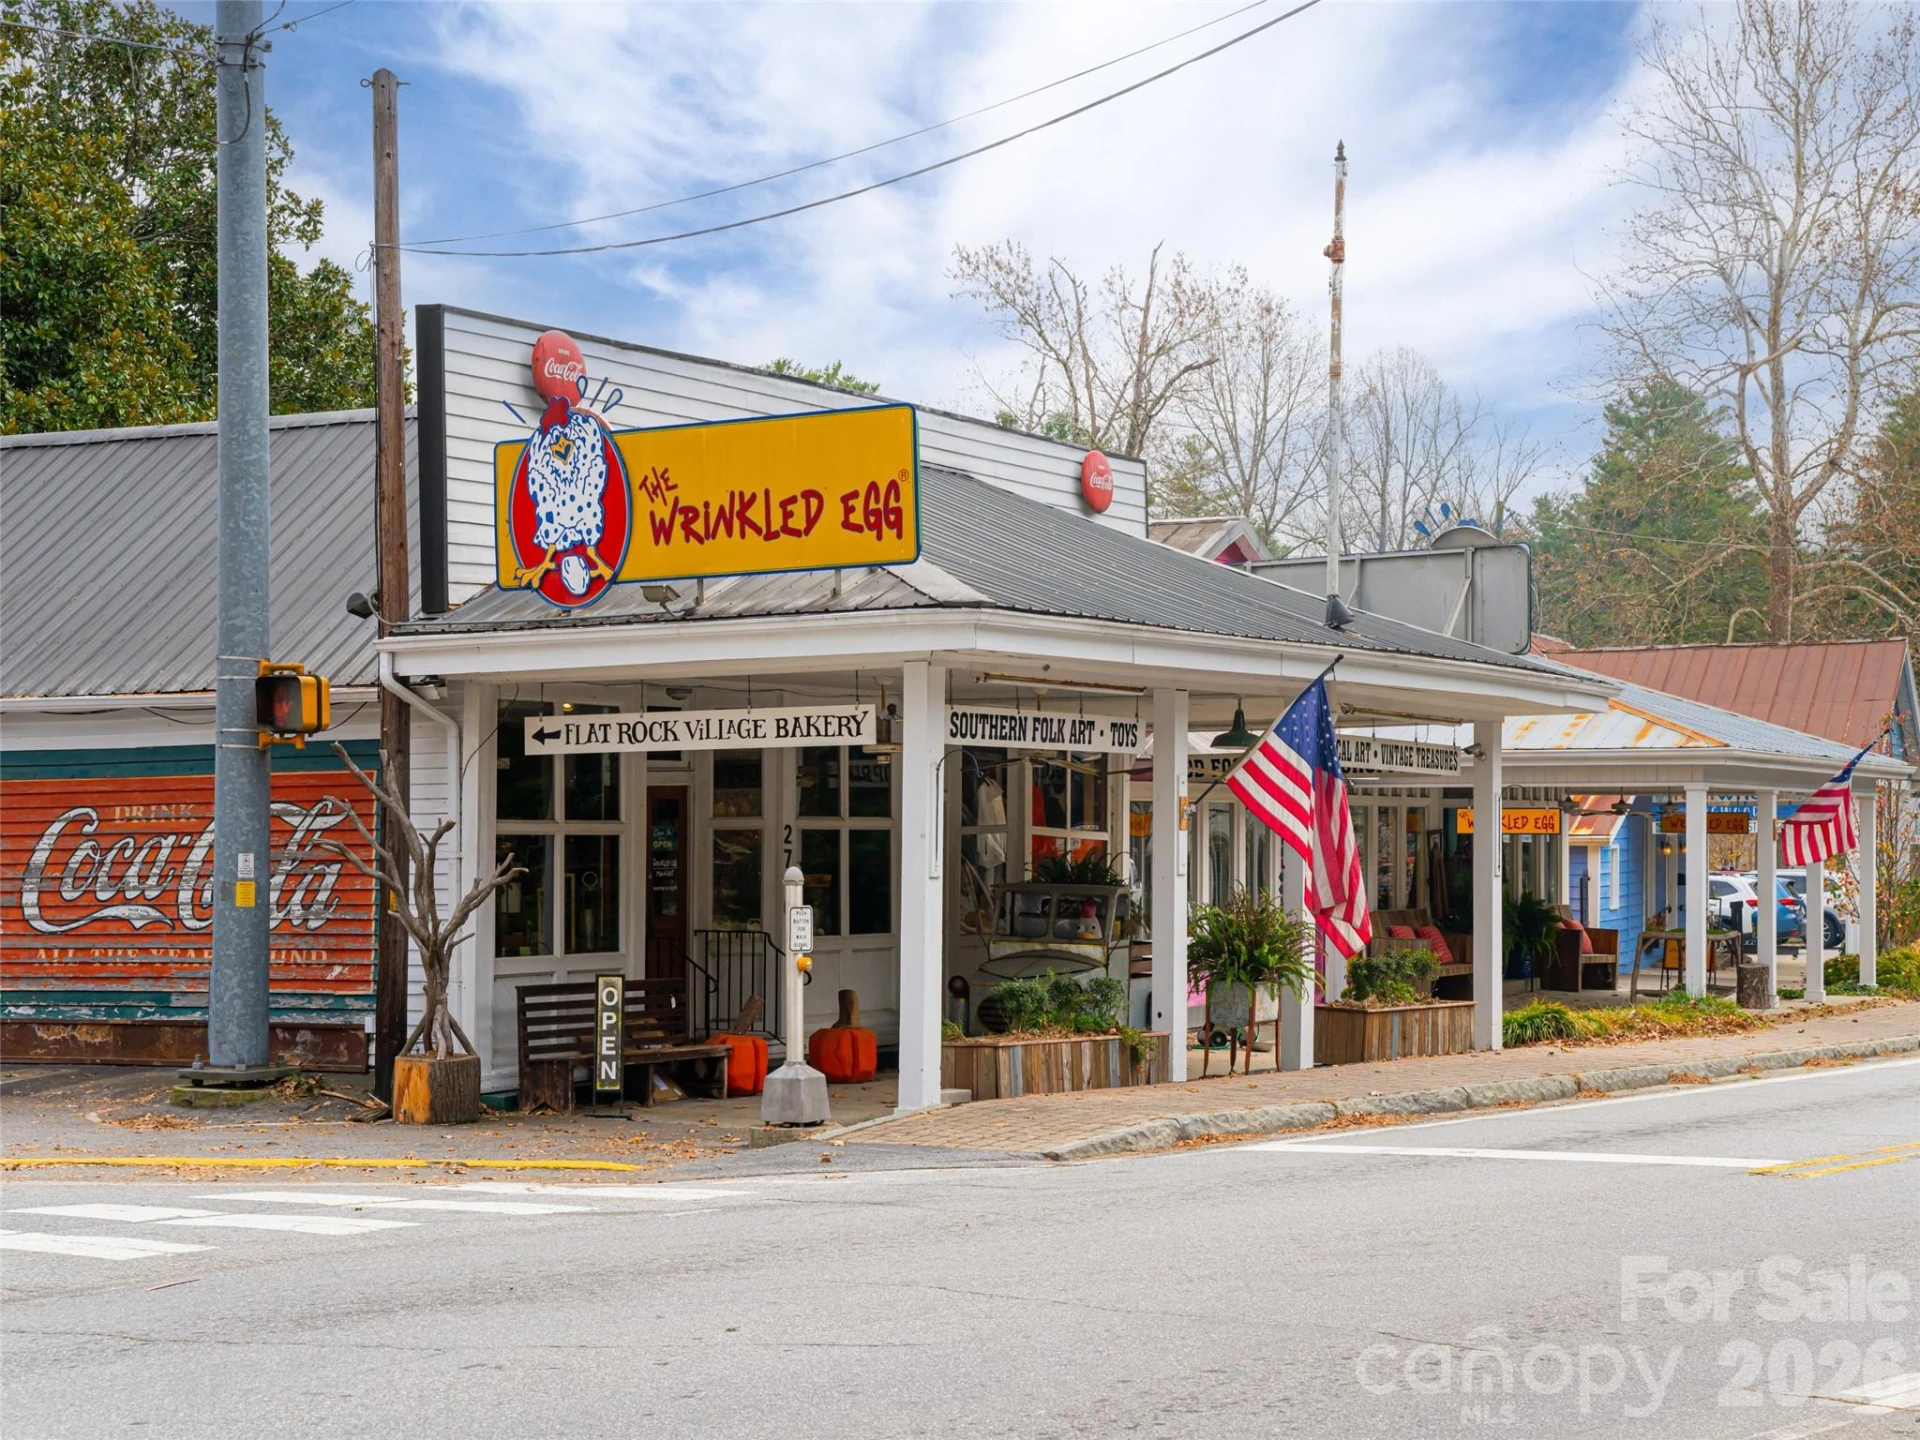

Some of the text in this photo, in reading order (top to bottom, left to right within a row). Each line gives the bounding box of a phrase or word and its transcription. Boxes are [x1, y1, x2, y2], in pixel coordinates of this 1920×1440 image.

[639, 466, 678, 507] THE
[840, 479, 903, 541] EGG
[564, 722, 611, 745] FLAT
[620, 720, 680, 744] ROCK
[775, 711, 870, 739] BAKERY
[949, 711, 1138, 747] SOUTHERN FOLK ART TOYS
[1336, 739, 1458, 771] CAL ART VINTAGE TREASURES
[114, 804, 196, 822] DRINK
[1534, 815, 1555, 831] EGG
[652, 840, 673, 849] OPEN
[33, 949, 80, 967] ALL
[90, 949, 140, 967] THE
[600, 986, 619, 1081] OPEN
